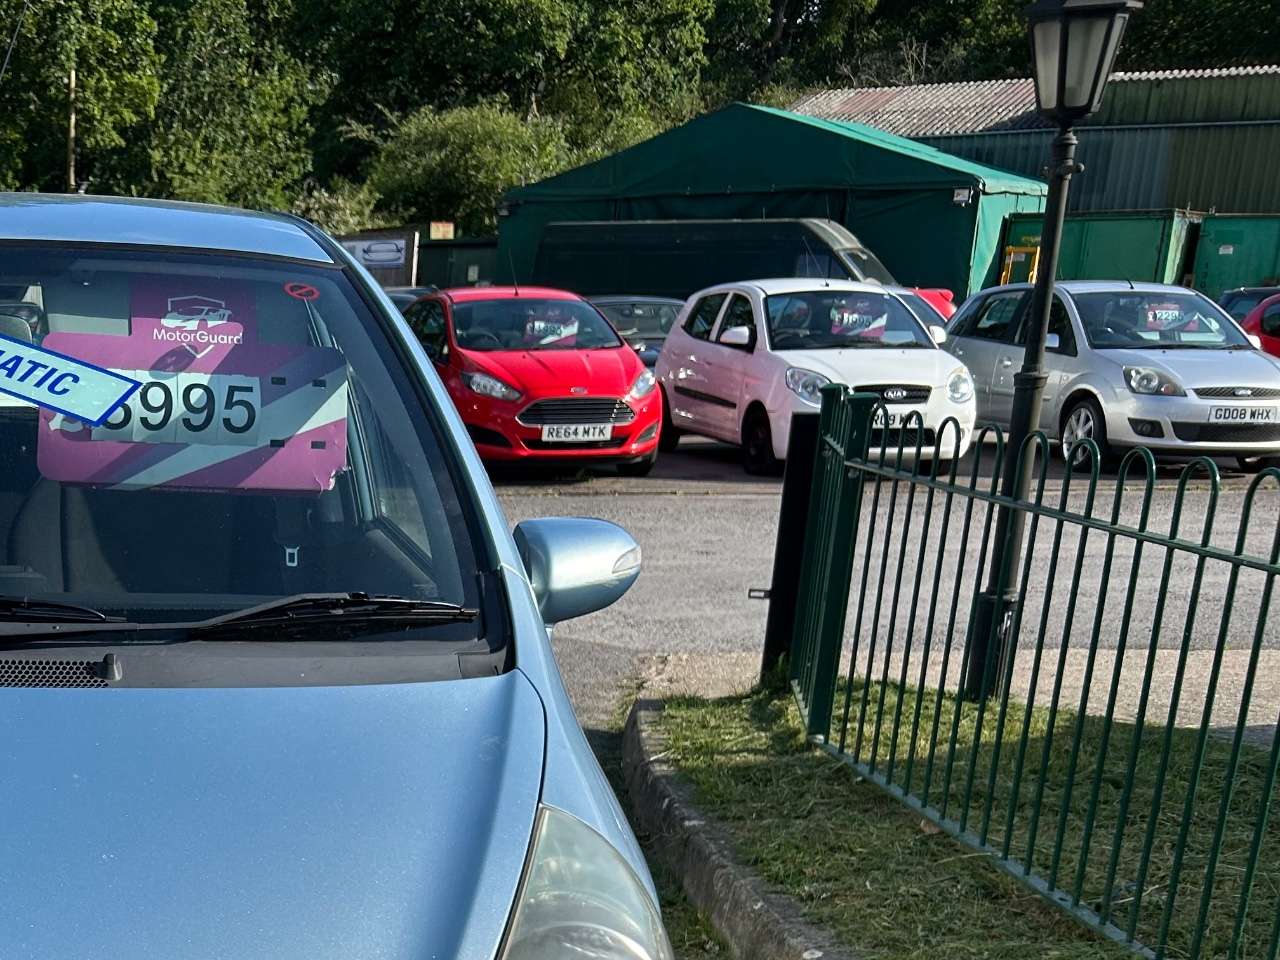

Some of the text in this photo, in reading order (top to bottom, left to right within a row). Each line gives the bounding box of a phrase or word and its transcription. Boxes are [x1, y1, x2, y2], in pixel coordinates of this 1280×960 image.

[153, 328, 243, 345] MotorGuard
[1214, 408, 1271, 420] GD08 WHX
[547, 426, 606, 439] RE64 MTK
